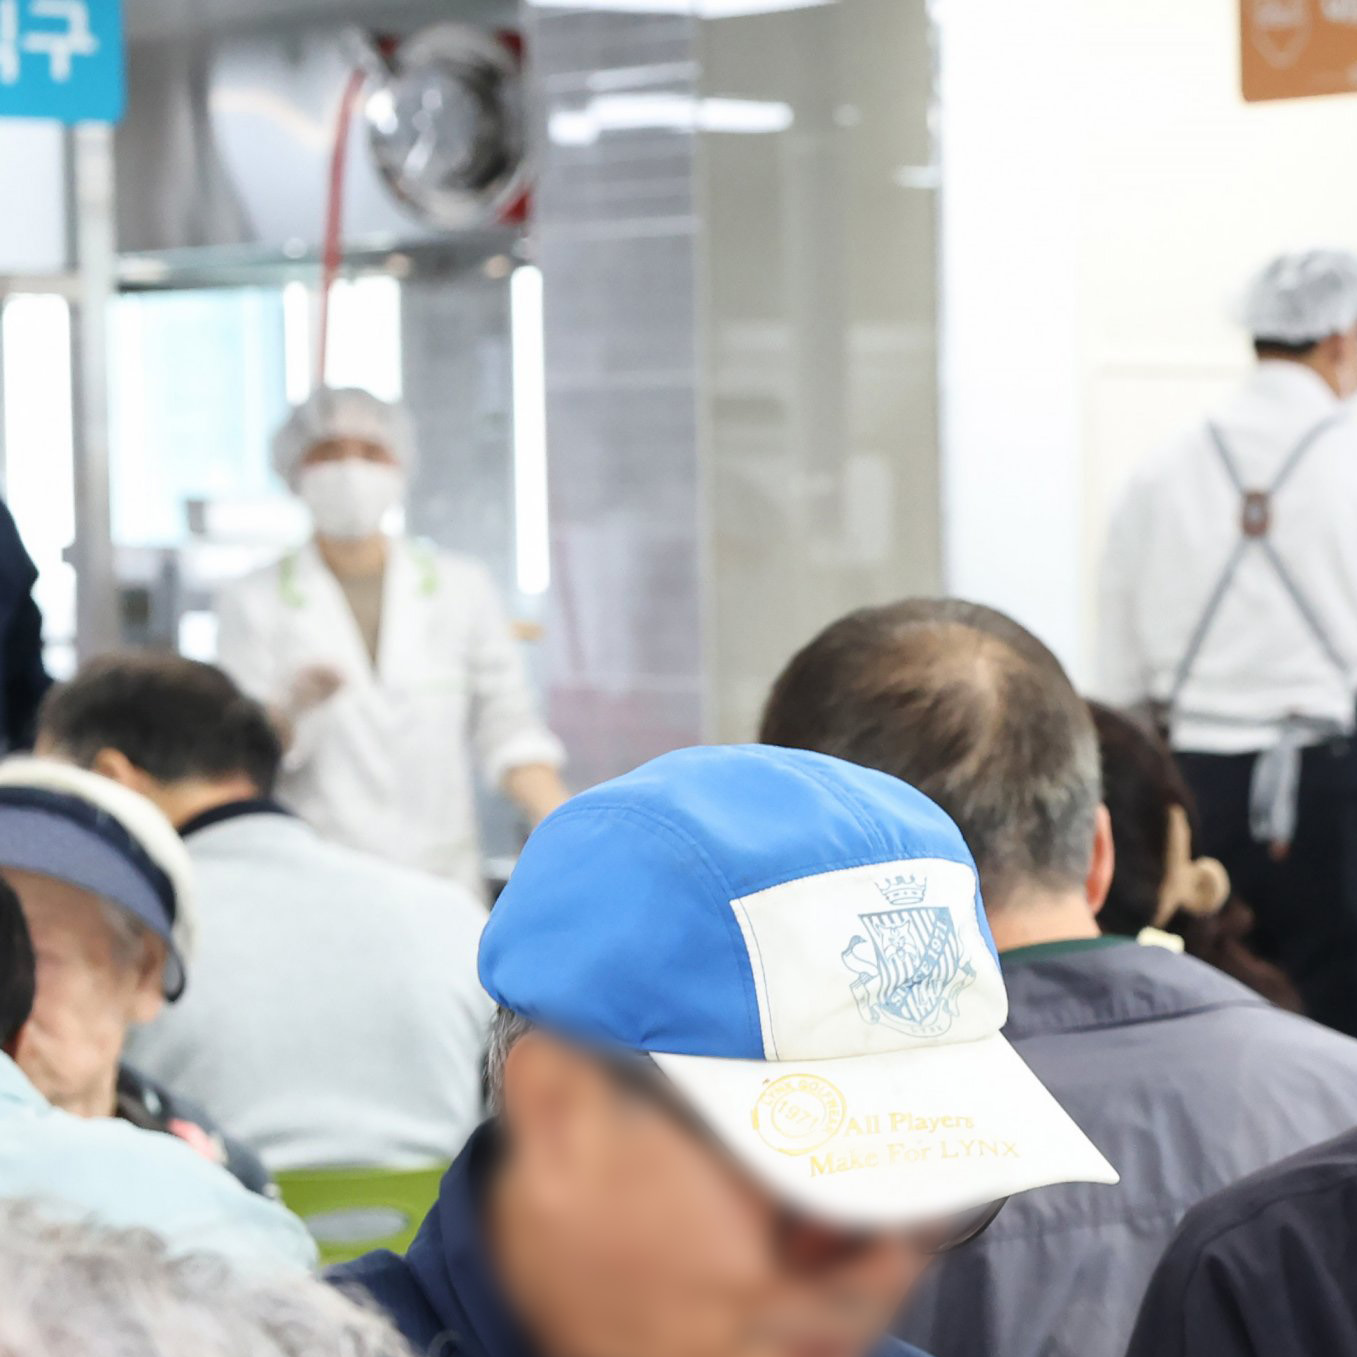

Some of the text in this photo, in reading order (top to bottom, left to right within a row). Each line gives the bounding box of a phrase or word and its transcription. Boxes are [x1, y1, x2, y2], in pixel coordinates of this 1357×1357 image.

[929, 920, 949, 961] 1971
[844, 1111, 975, 1137] All Players
[809, 1138, 1021, 1178] Make For LYNX
